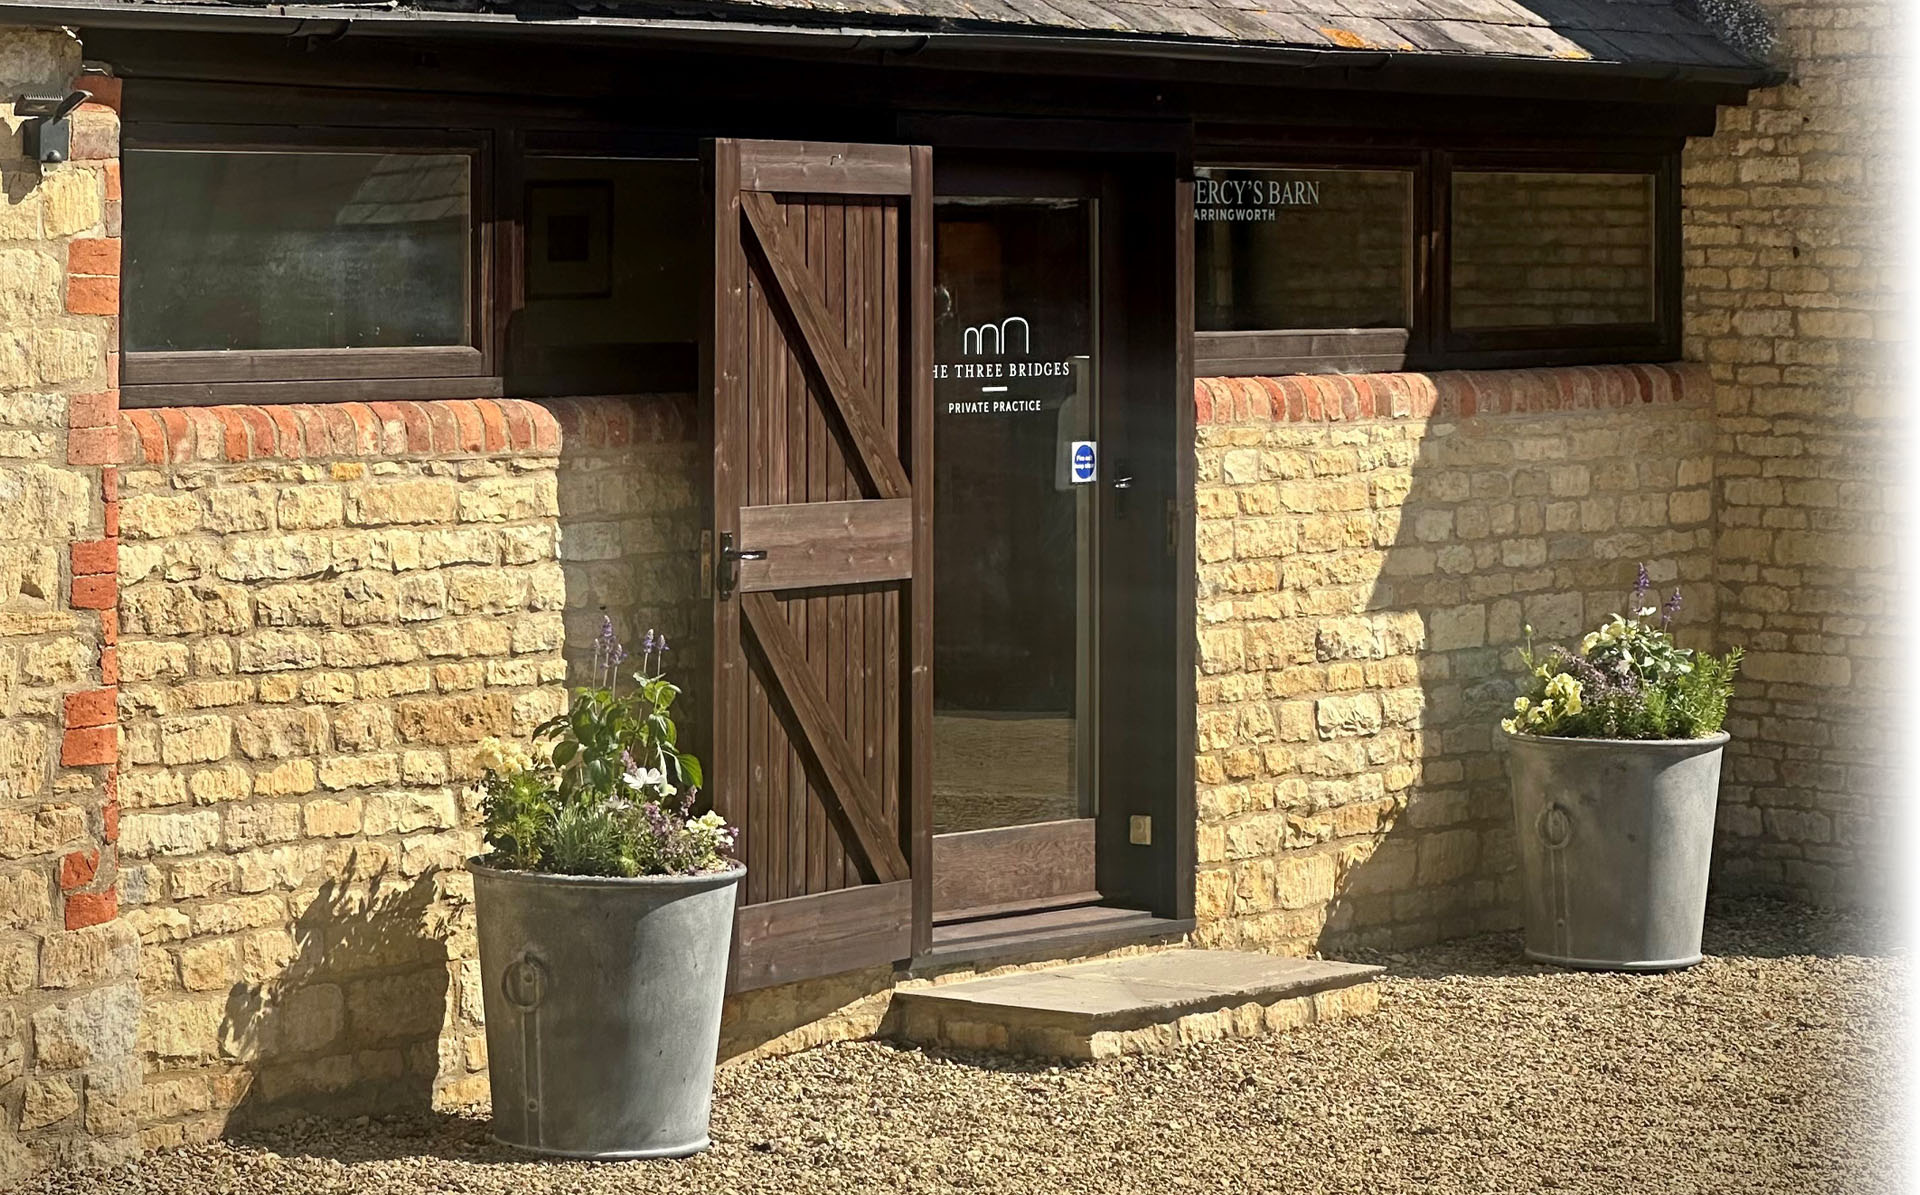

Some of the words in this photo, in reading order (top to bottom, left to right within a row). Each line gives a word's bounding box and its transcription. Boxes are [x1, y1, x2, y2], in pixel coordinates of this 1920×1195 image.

[1194, 180, 1263, 205] ERCY'S
[1268, 180, 1320, 205] BARN
[954, 363, 1003, 378] THREE
[1009, 361, 1070, 377] BRIDGES
[948, 402, 989, 414] PRIVATE
[993, 400, 1041, 412] PRACTICE
